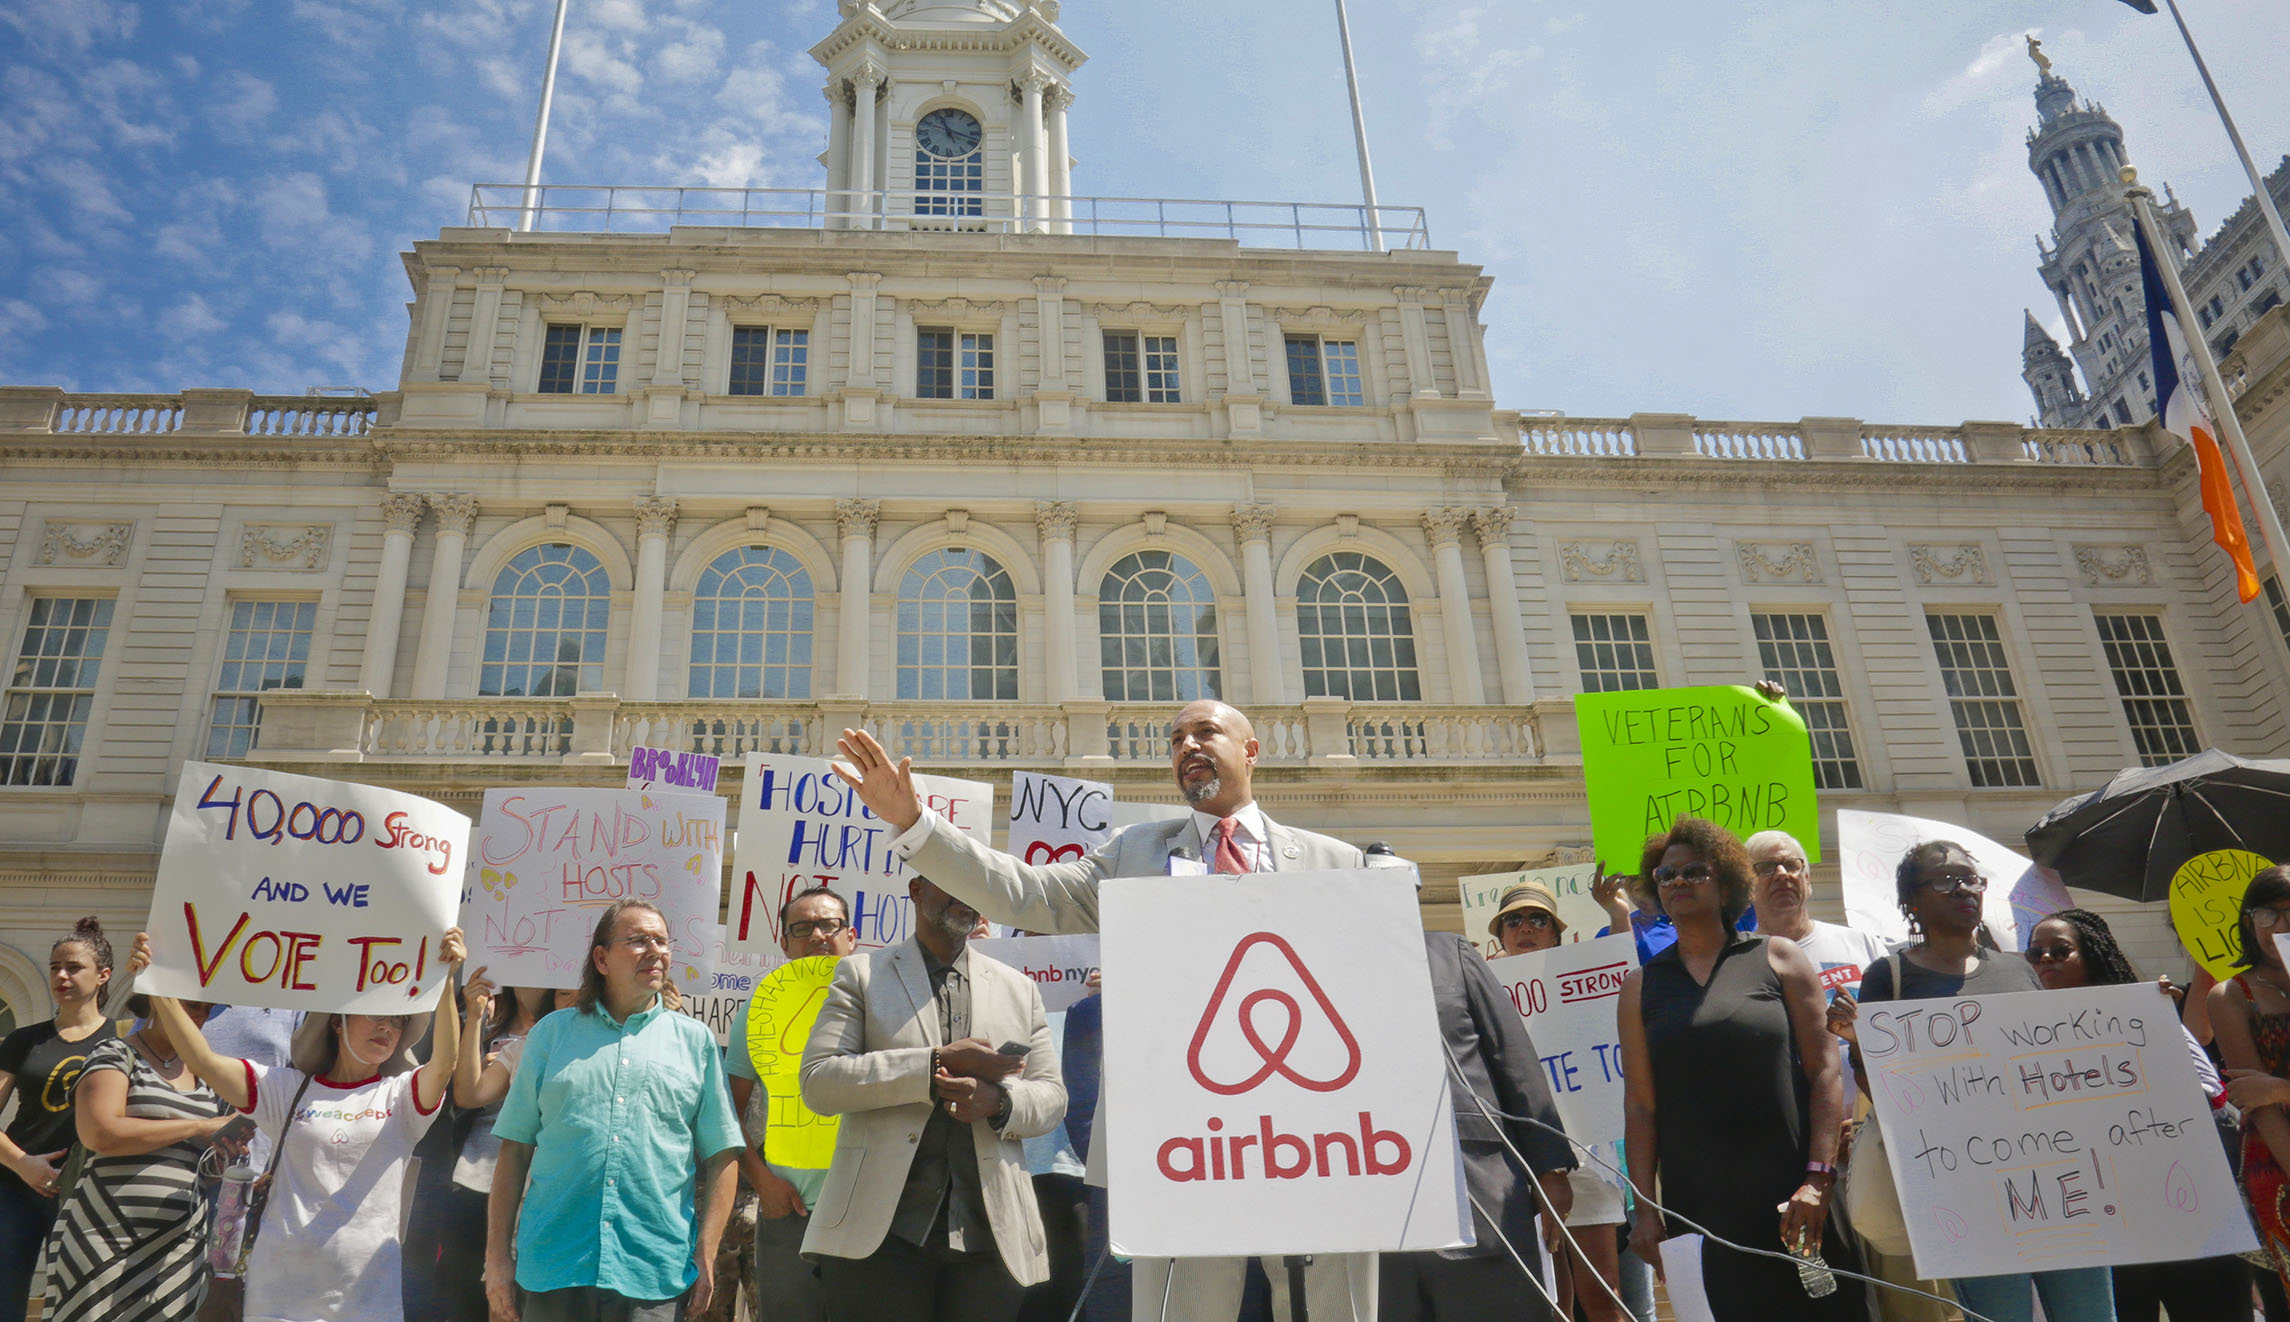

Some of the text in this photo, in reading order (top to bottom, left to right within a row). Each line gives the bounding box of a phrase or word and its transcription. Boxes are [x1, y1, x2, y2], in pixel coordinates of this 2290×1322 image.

[1603, 704, 1772, 746] VETERANS
[1665, 741, 1737, 779] FOR
[197, 774, 452, 875] 40,000 Strong
[914, 793, 972, 830] RE
[1011, 776, 1108, 832] NYC
[482, 796, 720, 867] STAND WITH
[251, 877, 371, 907] AND WE
[562, 863, 662, 900] HOSTS
[485, 896, 567, 946] NOT
[2193, 899, 2226, 927] IS
[184, 902, 324, 991] VOTE
[747, 956, 835, 1077] HOMESHARING
[1862, 1000, 2145, 1059] STOP working
[2018, 1057, 2138, 1102] Hotels
[295, 1107, 393, 1122] #weaccept
[1157, 1111, 1412, 1182] airbnb
[1915, 1108, 2195, 1179] to come after
[2003, 1146, 2118, 1223] ME!
